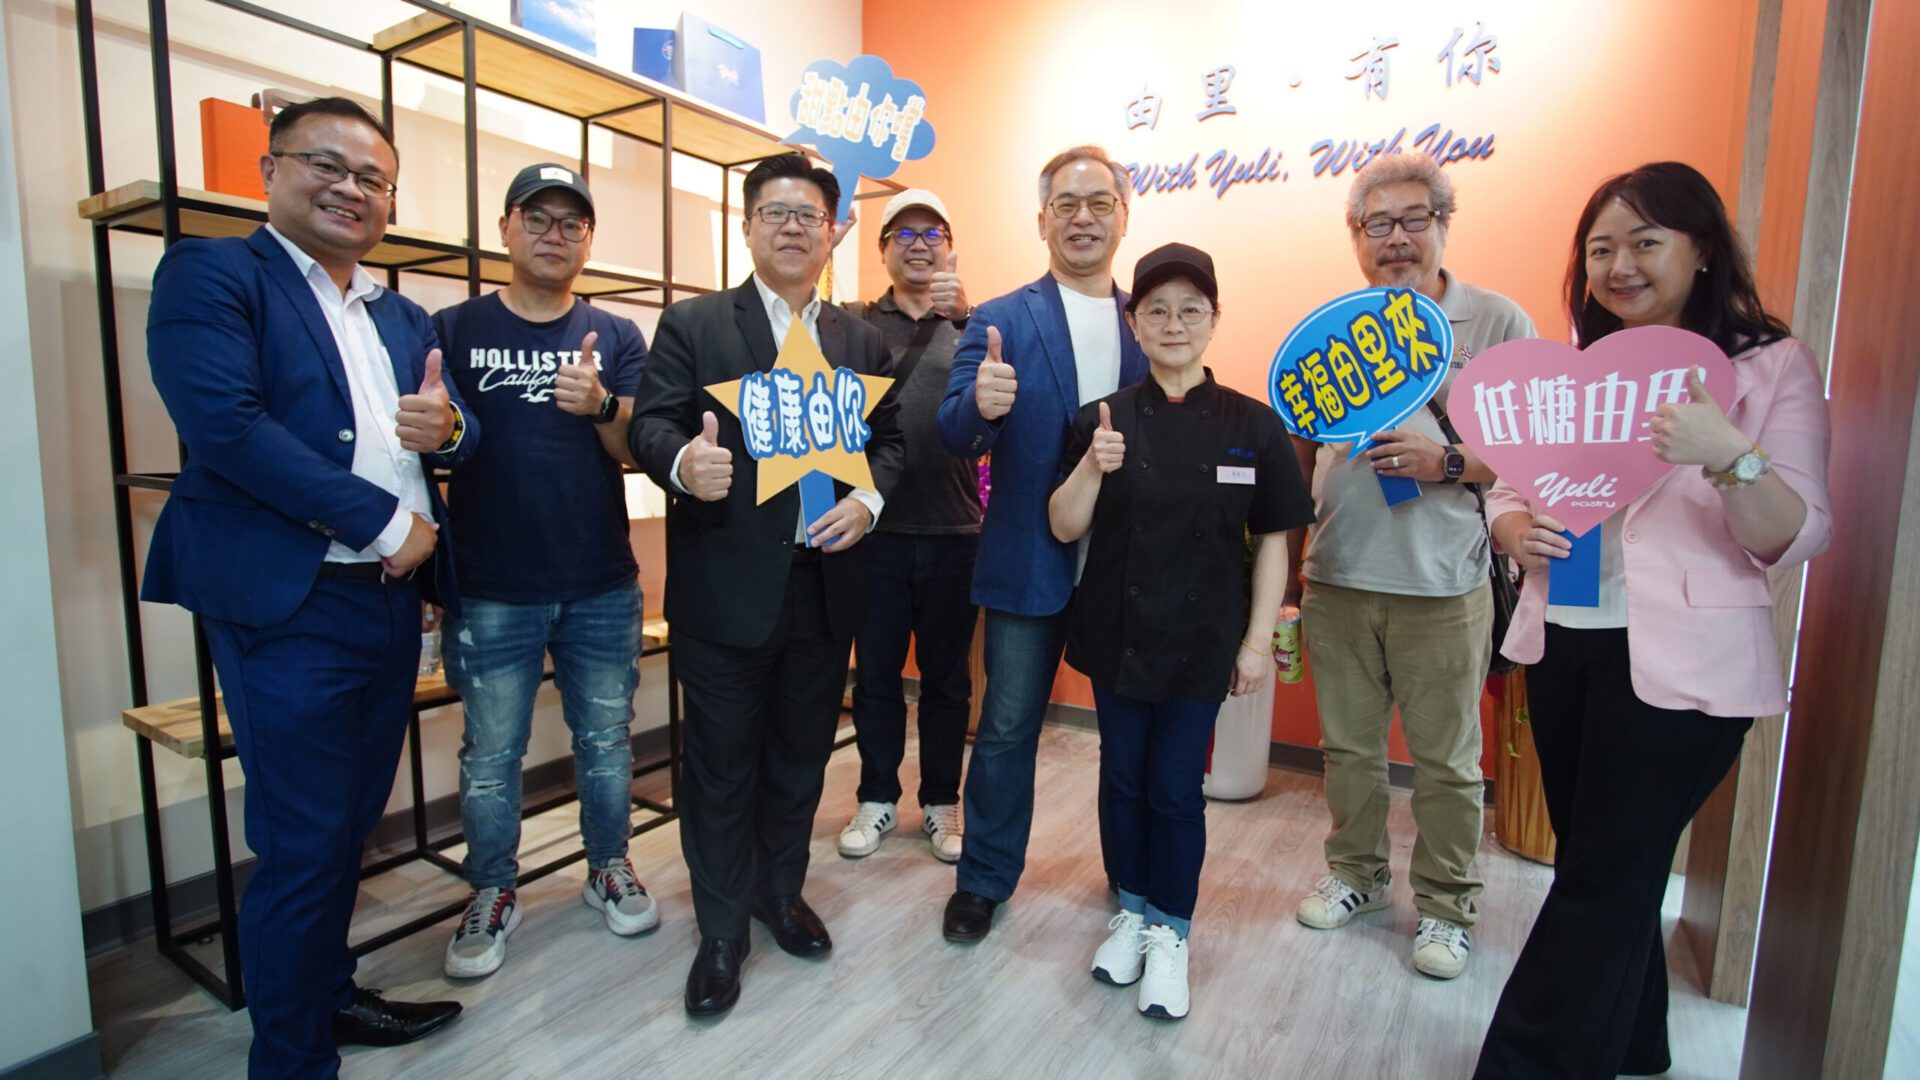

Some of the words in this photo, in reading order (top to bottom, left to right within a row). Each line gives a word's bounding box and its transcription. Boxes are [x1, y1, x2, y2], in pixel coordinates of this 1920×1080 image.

[1126, 152, 1200, 196] With
[1310, 127, 1406, 177] With
[1414, 123, 1495, 167] You
[741, 370, 869, 456] 健康由你
[1533, 472, 1619, 507] Yuli
